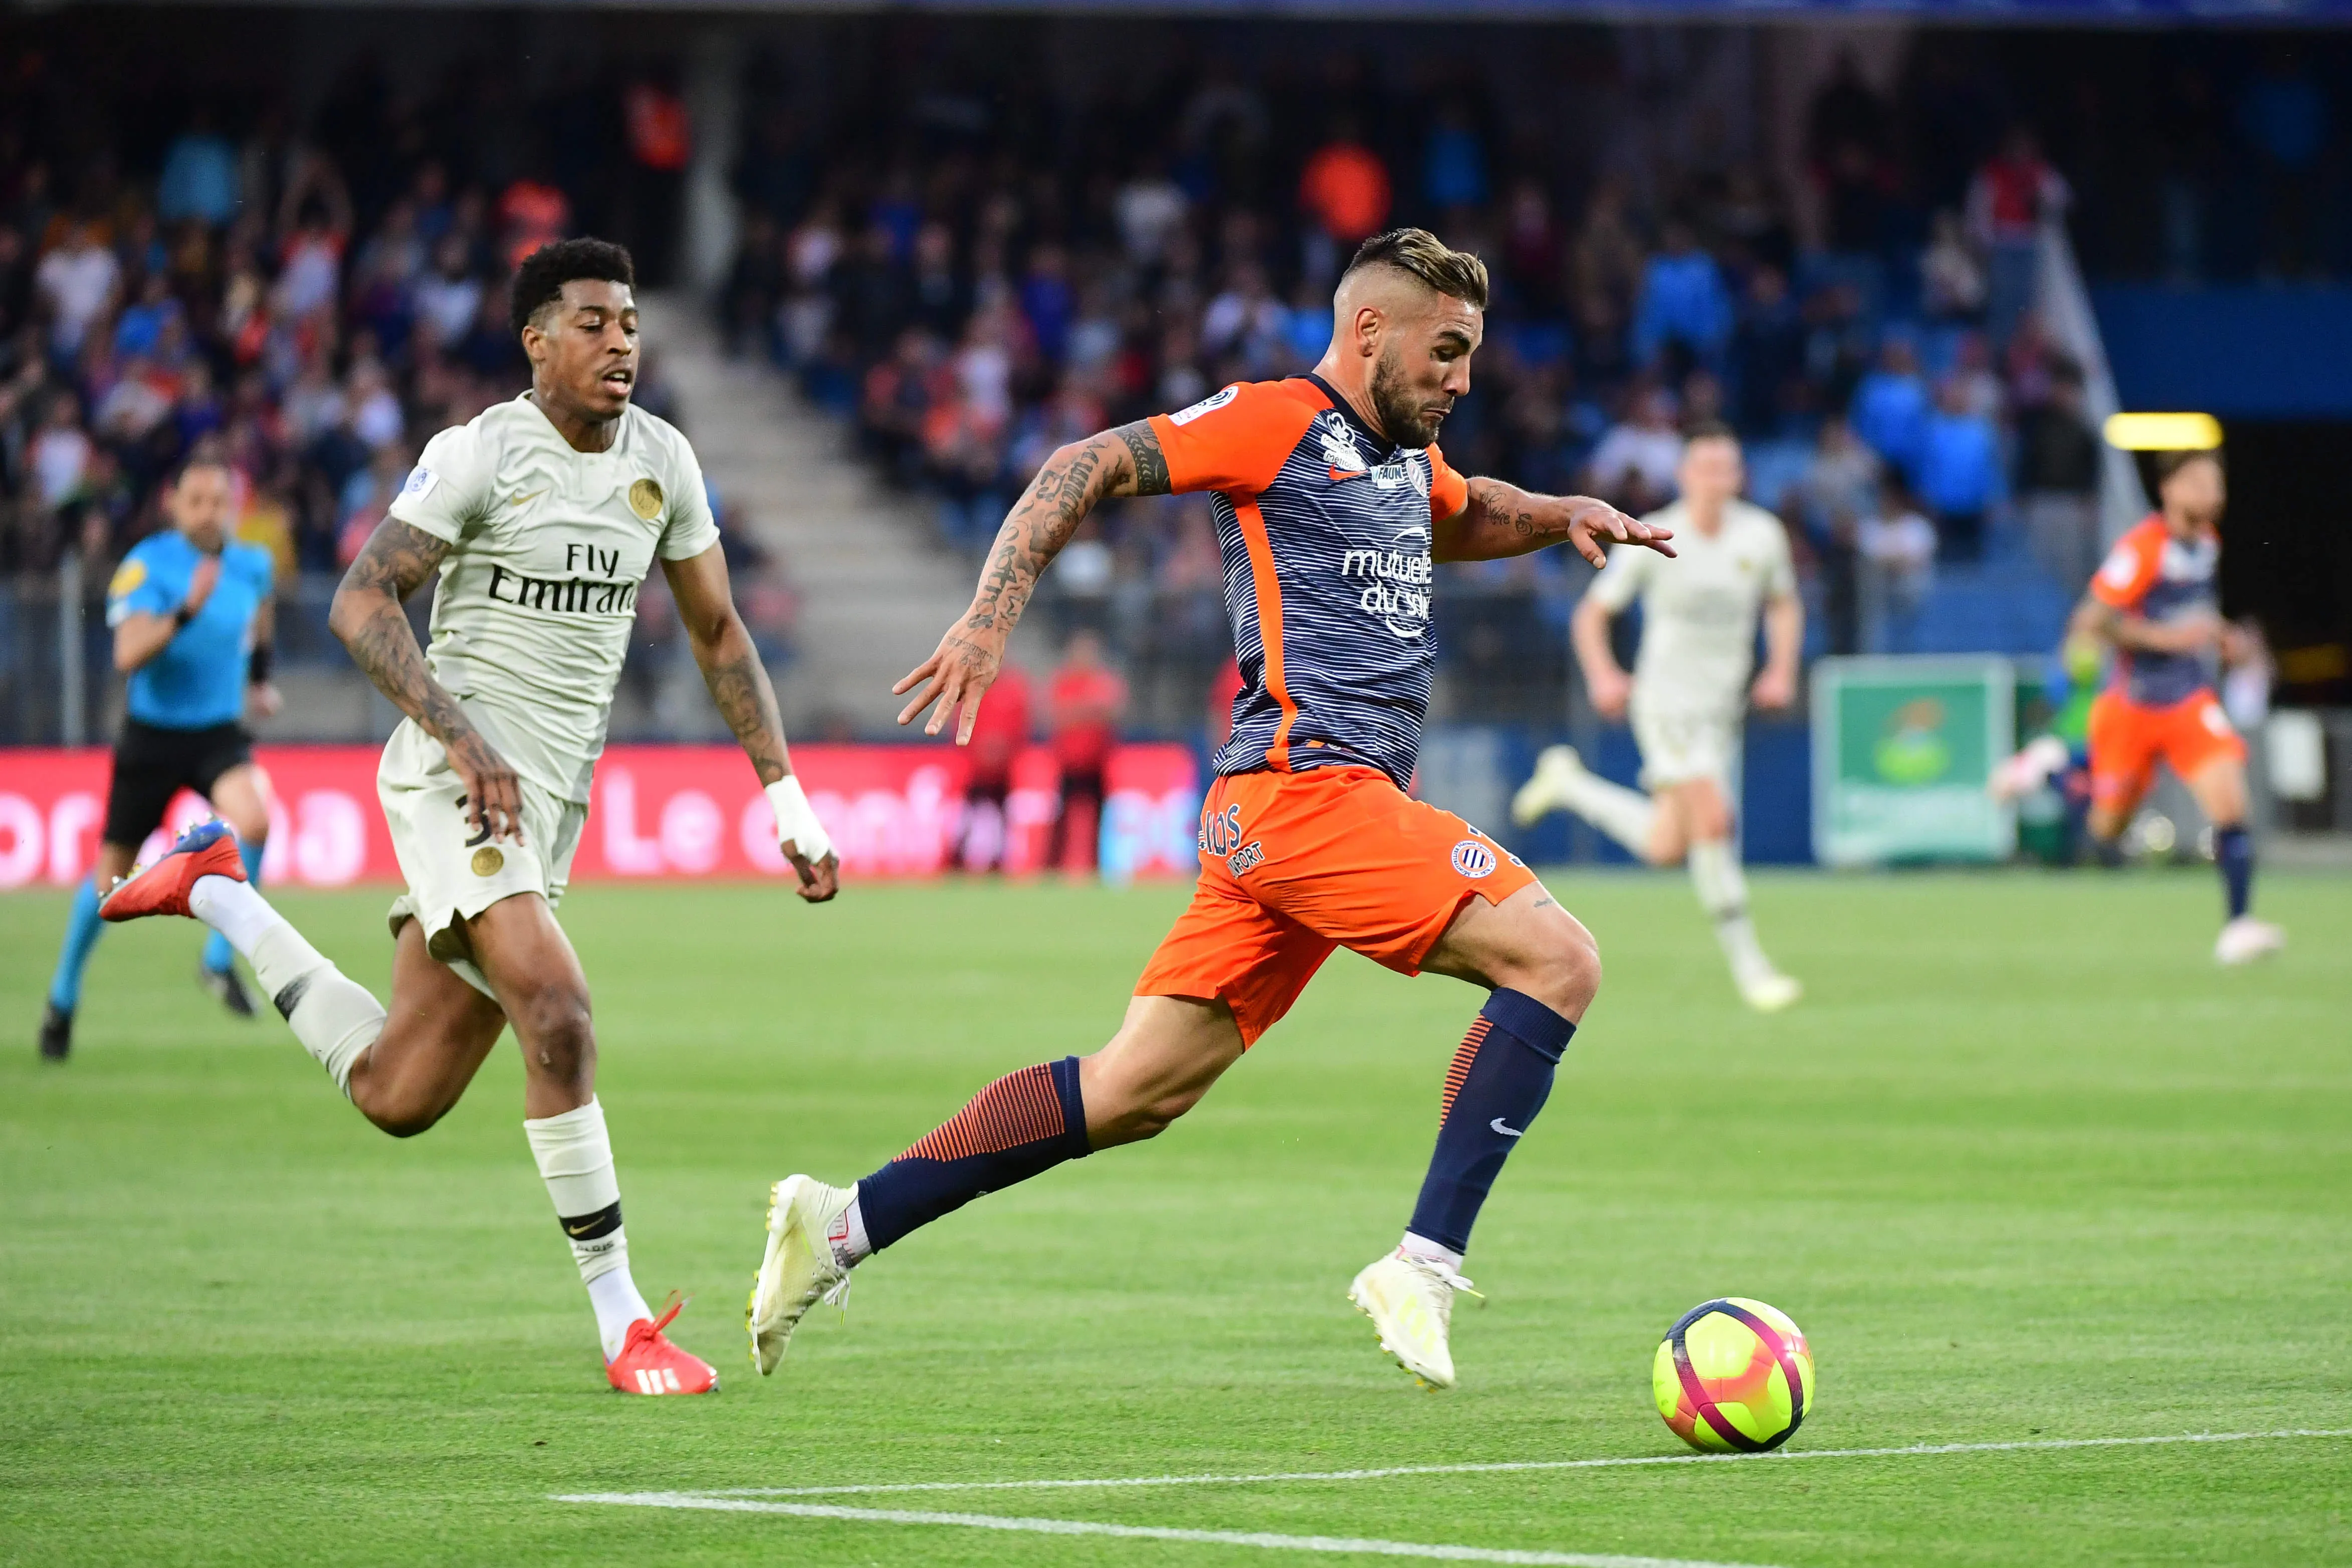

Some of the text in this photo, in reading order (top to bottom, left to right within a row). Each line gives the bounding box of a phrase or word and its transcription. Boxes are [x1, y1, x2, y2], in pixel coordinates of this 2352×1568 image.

[1378, 467, 1402, 480] FAUN
[567, 543, 619, 578] Fly
[1361, 580, 1400, 613] du
[601, 767, 722, 874] Le
